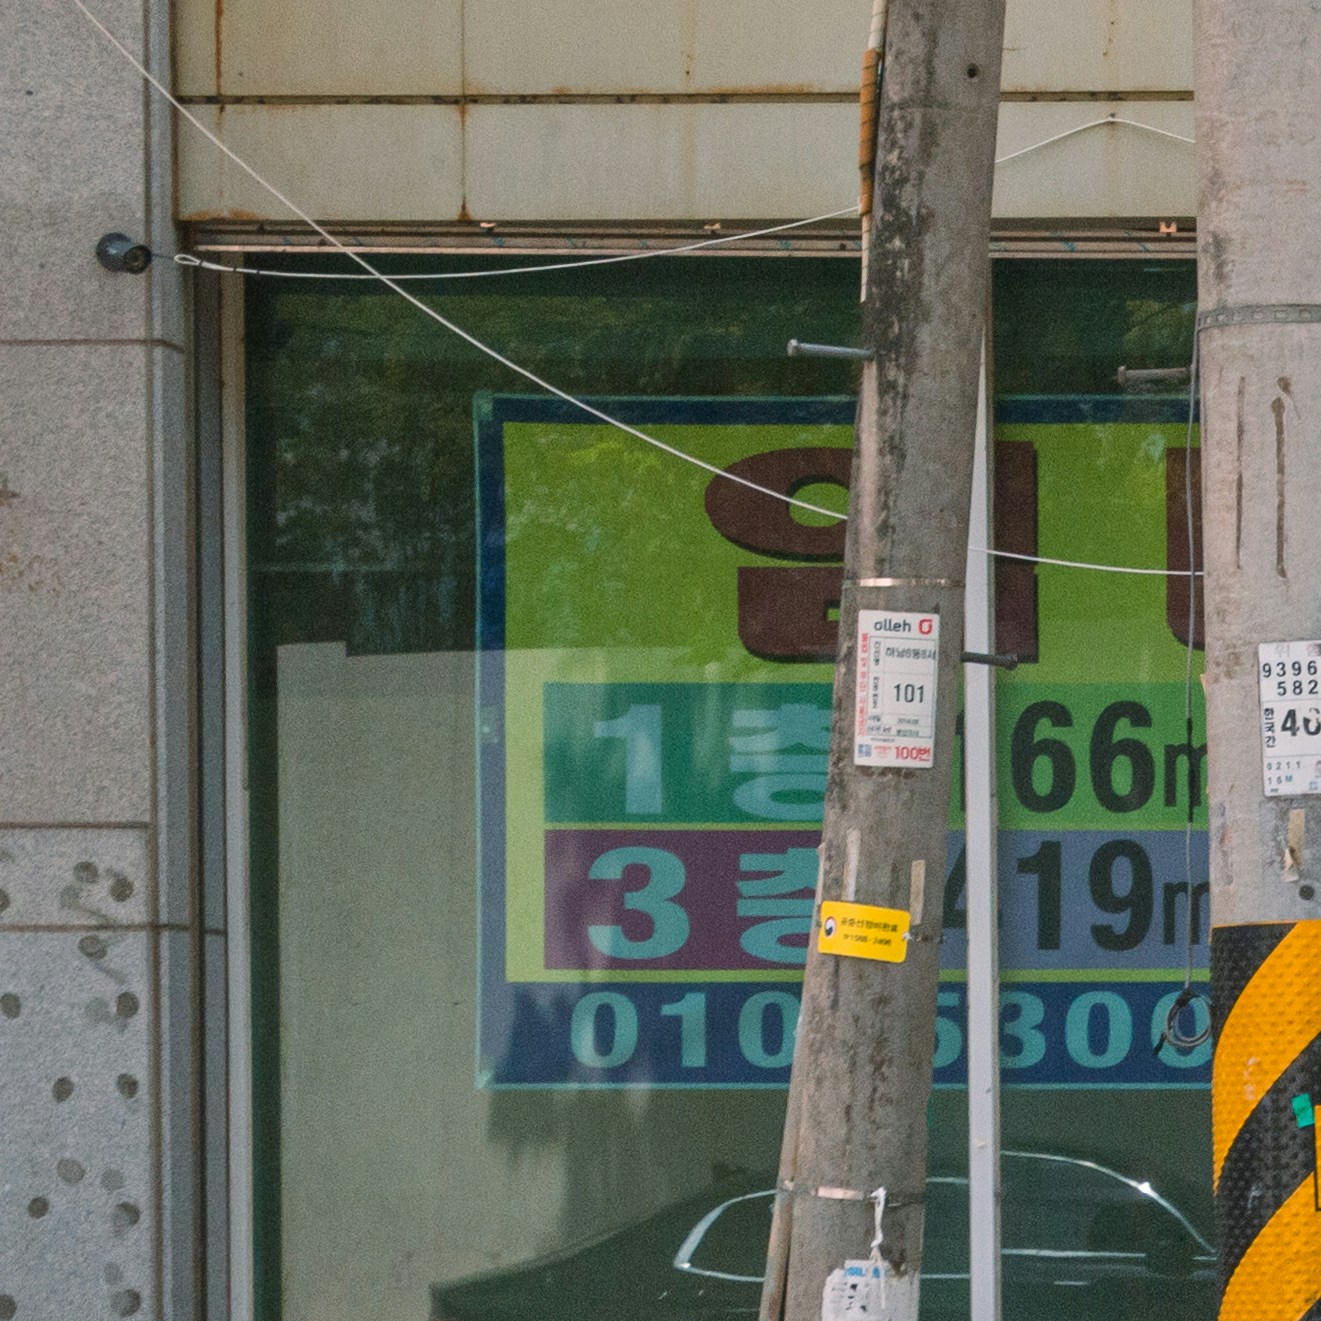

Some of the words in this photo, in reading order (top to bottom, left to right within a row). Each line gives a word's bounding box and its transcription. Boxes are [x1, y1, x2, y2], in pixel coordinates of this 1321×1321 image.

[874, 618, 912, 632] olleh
[894, 683, 924, 703] 101
[1277, 679, 1319, 696] 582
